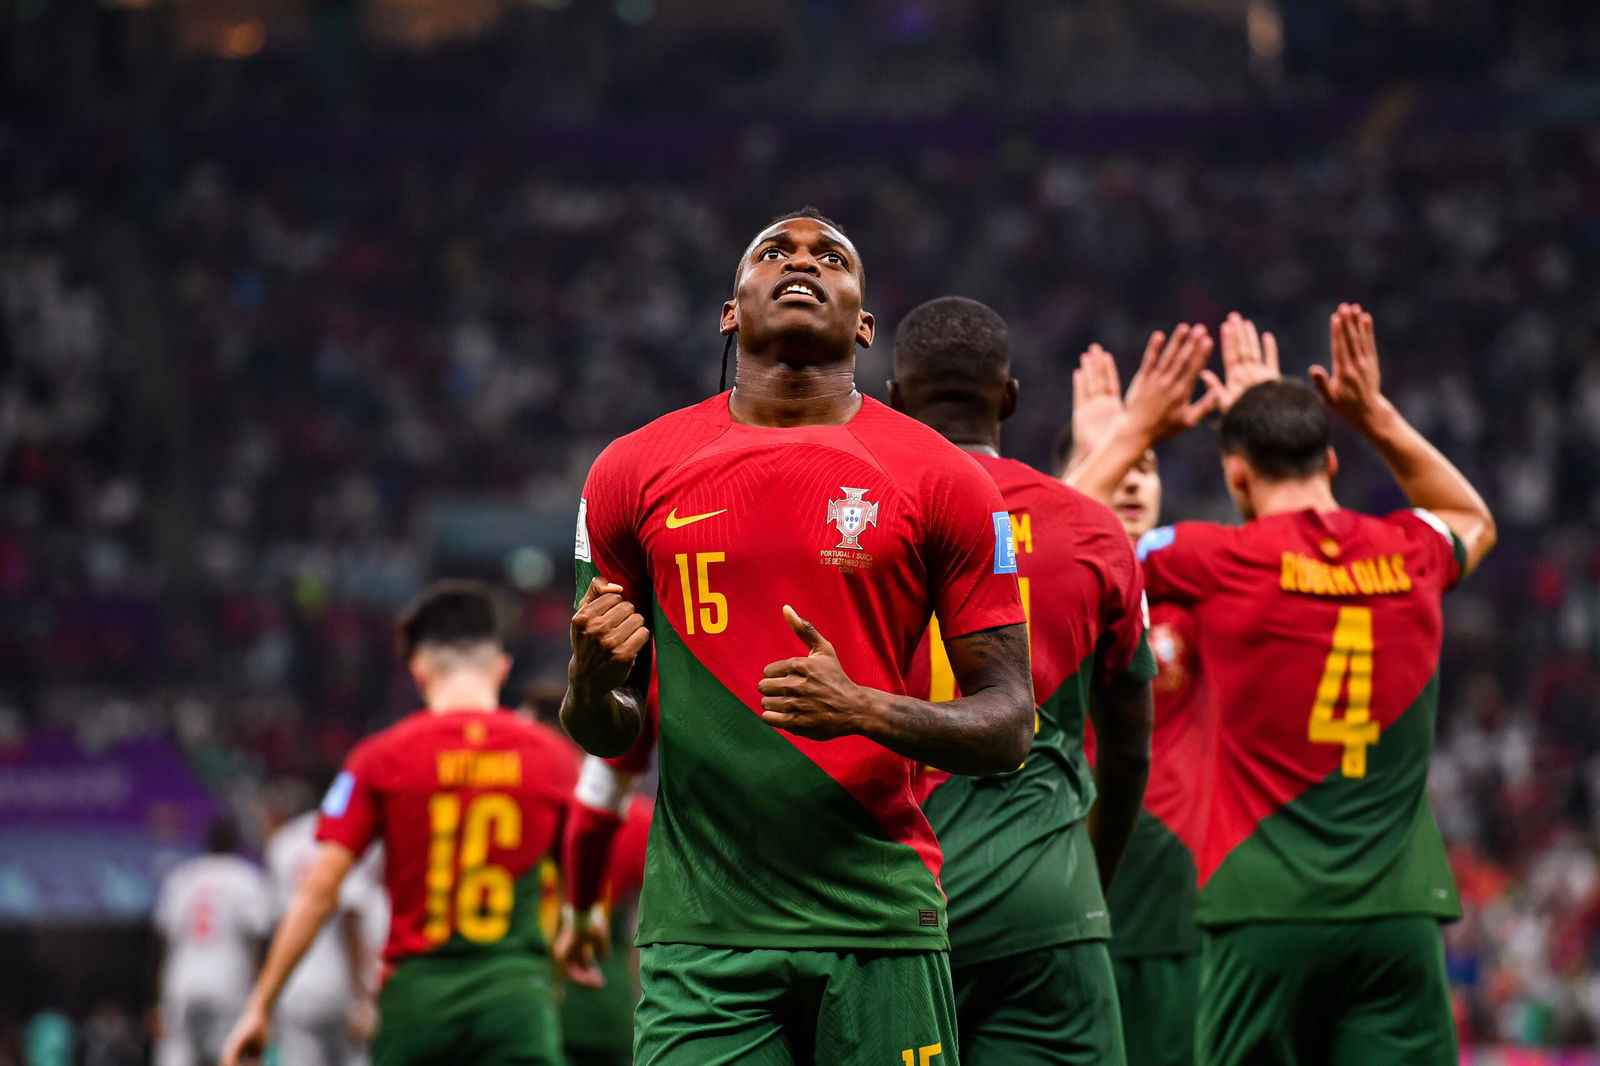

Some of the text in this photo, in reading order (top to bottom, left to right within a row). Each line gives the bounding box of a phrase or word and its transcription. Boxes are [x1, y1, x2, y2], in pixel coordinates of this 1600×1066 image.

[675, 551, 728, 635] 15
[820, 550, 850, 558] PORTUGAL
[1308, 606, 1380, 778] 4
[425, 792, 523, 943] 16
